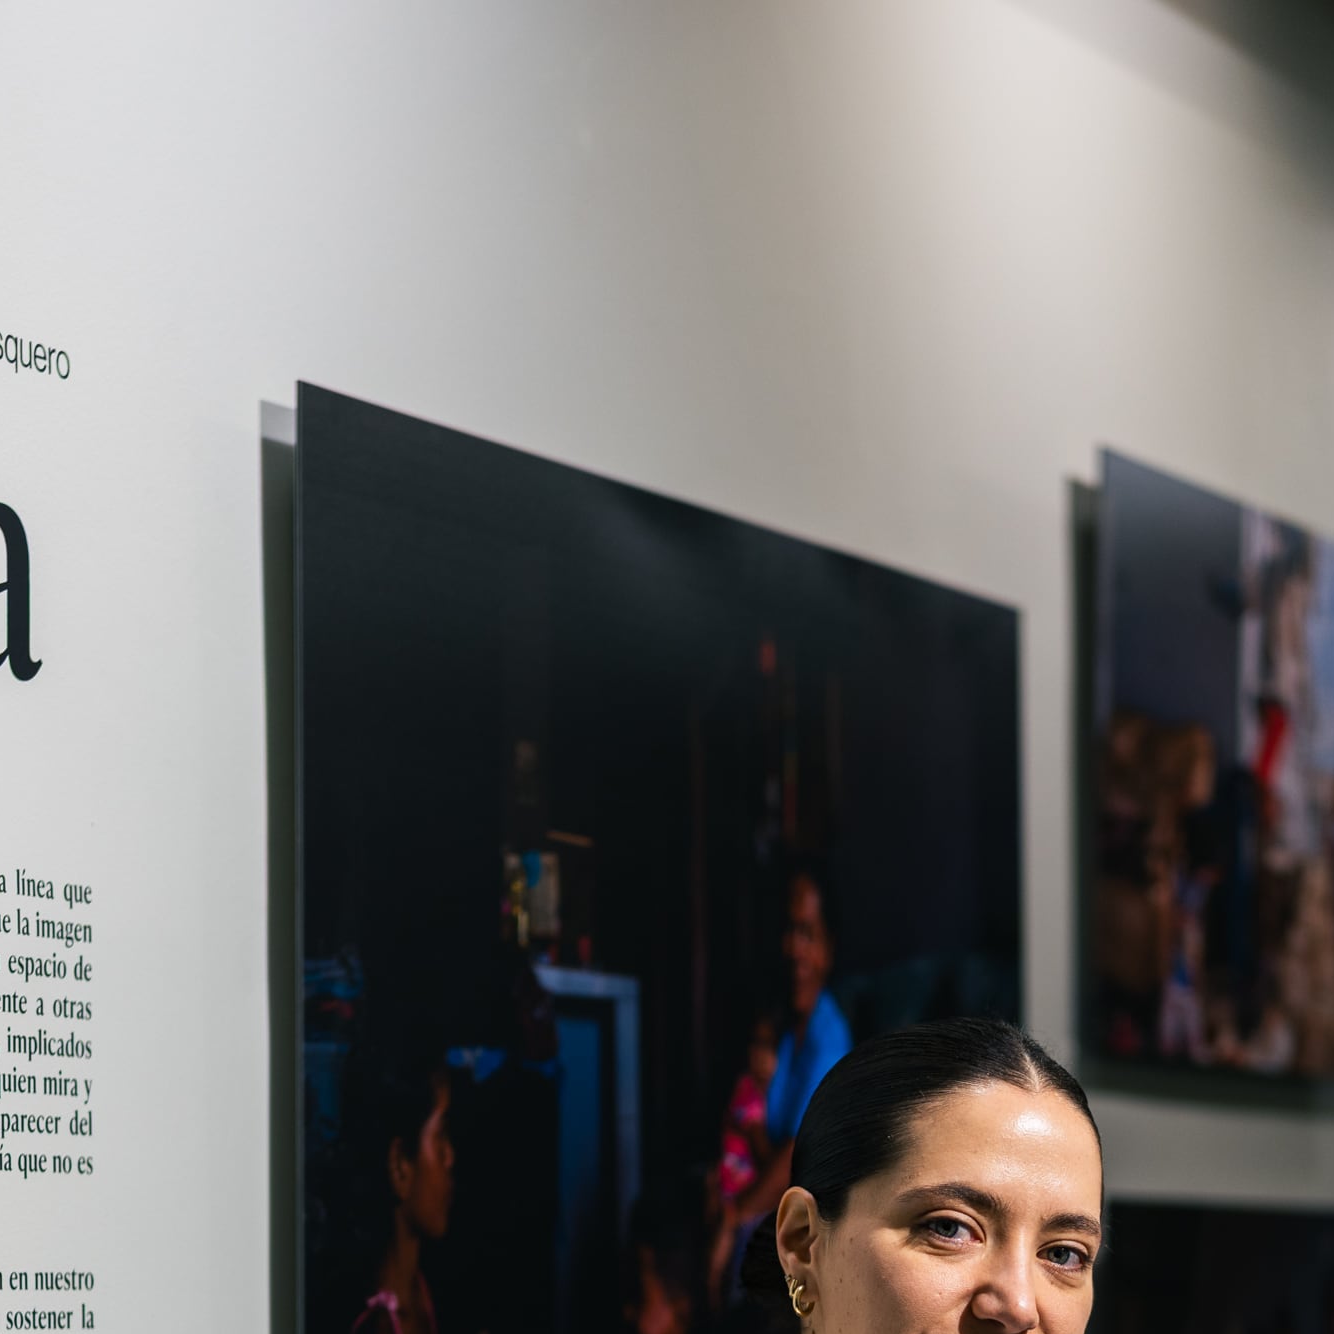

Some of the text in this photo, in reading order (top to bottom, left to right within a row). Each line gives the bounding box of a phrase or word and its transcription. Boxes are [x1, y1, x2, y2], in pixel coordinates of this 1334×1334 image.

[15, 868, 55, 900] línea
[63, 883, 92, 910] que
[16, 908, 31, 937] la
[35, 911, 93, 949] imagen
[35, 997, 45, 1017] a
[52, 997, 92, 1021] otras
[6, 1026, 92, 1062] implicados
[69, 1109, 93, 1137] del
[8, 1271, 29, 1291] en
[34, 1269, 95, 1291] nuestro
